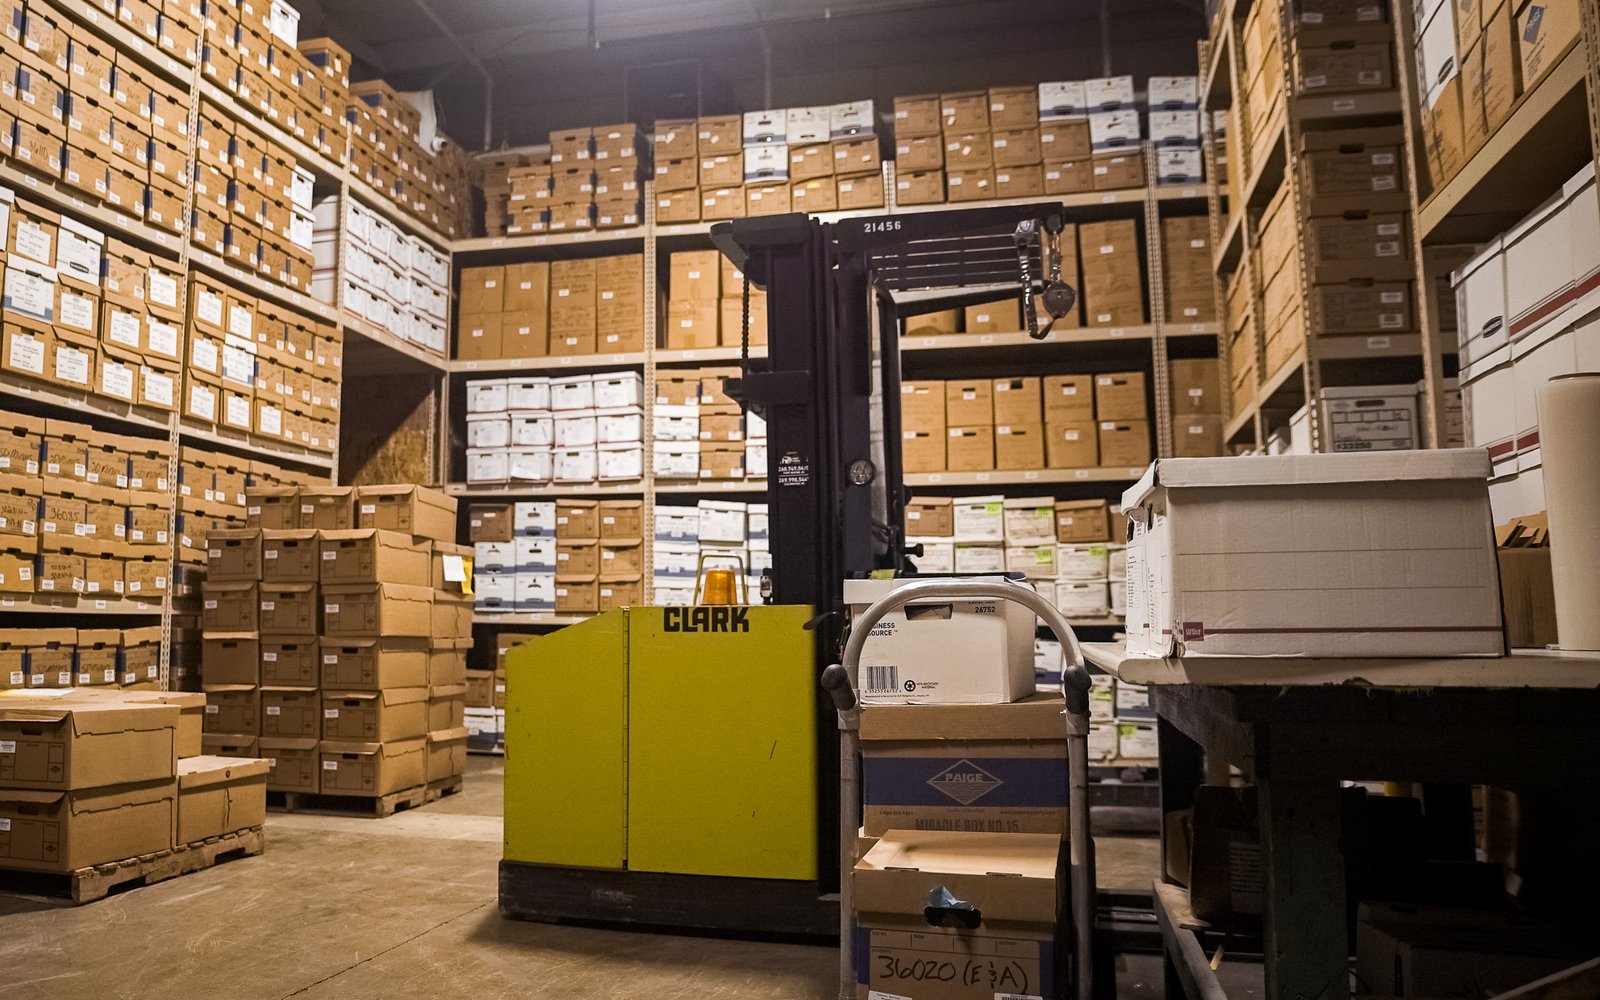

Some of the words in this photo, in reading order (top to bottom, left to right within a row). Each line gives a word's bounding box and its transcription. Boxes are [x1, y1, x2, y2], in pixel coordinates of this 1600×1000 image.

[864, 221, 901, 232] 21456
[664, 607, 749, 632] CLARK
[945, 773, 984, 783] PAIGE
[915, 818, 961, 832] MIRACLE
[964, 819, 985, 832] BOX
[878, 955, 956, 982] 36020
